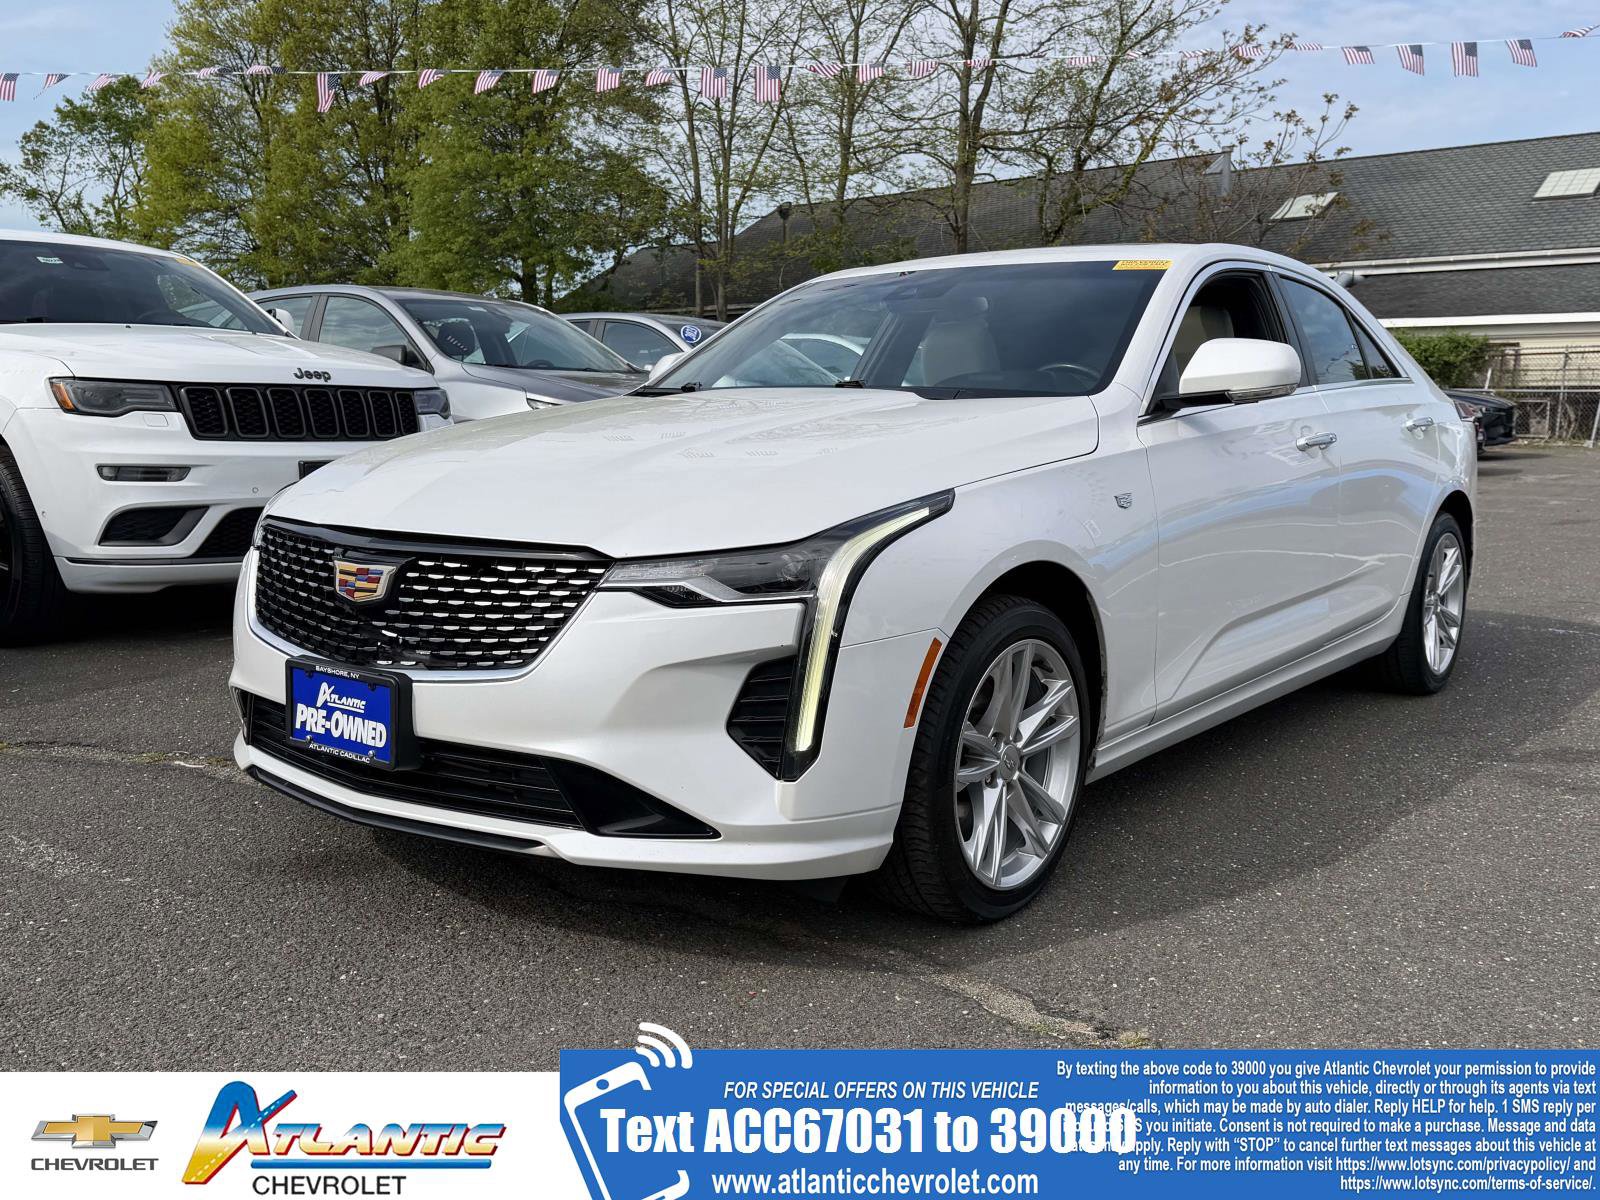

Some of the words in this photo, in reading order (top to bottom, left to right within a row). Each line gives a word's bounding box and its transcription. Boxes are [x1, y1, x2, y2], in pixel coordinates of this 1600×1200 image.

[293, 367, 332, 383] Jeep
[315, 665, 350, 678] BAYSHORE,
[316, 681, 367, 709] ATLANTIC
[295, 703, 387, 748] PRE-OWNED
[309, 743, 339, 755] ATLANTIC
[340, 750, 371, 764] CADILLAC
